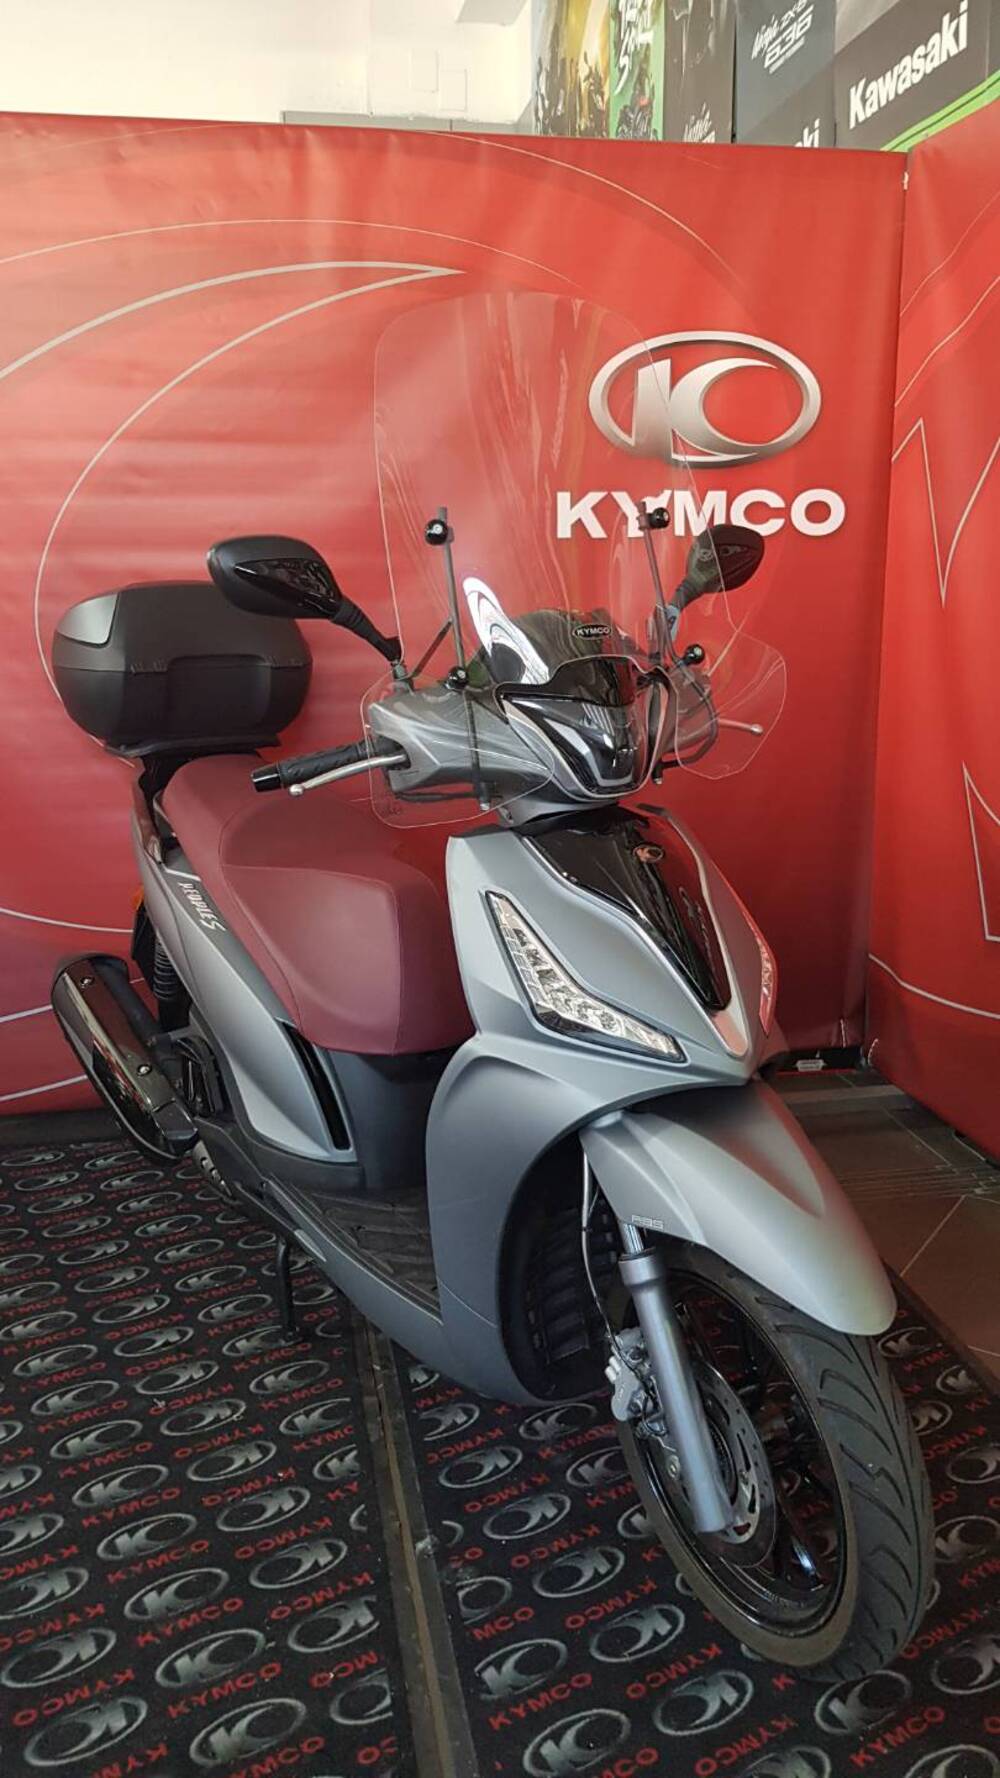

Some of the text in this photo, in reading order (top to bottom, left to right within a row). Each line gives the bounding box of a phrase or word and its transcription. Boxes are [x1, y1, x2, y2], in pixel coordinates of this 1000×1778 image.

[849, 0, 968, 130] Kawasaki
[556, 488, 846, 539] KYMCO
[576, 626, 610, 636] KYMCO
[67, 1256, 142, 1279] KYMCO
[161, 1251, 235, 1274] KYMCO
[2, 1297, 68, 1317] YMCO
[183, 1277, 256, 1306] KYMCO
[105, 1312, 185, 1341] KYMCO
[20, 1361, 106, 1393] KYMCO
[123, 1345, 208, 1377] KYMCO
[232, 1343, 311, 1373] KYMCO
[147, 1383, 235, 1417] KYMCO
[257, 1377, 344, 1412] KYMCO
[36, 1399, 128, 1434] KYMCO
[172, 1423, 265, 1461] KYMCO
[292, 1425, 353, 1452] KYMC
[60, 1441, 154, 1479] KYMCO
[201, 1467, 296, 1507] KYMCO
[464, 1473, 549, 1513] KYMCO
[81, 1487, 182, 1529] KYMCO
[234, 1516, 333, 1560] KYMCO
[511, 1524, 600, 1568] KYMCO
[0, 1545, 79, 1580] KYMC
[107, 1539, 209, 1584] KYMCO
[268, 1572, 372, 1620] KYMCO
[564, 1579, 656, 1631] KYMCO
[135, 1597, 244, 1648] KYMCO
[471, 1606, 534, 1640] MCO
[166, 1661, 282, 1718] KYMCO
[308, 1651, 379, 1689] MCO
[625, 1643, 720, 1700] KYMCO
[10, 1667, 135, 1727] KYMCO
[488, 1673, 592, 1730] KYMCO
[226, 1736, 325, 1778] YMCO
[694, 1718, 794, 1778] KYMCO
[848, 1706, 947, 1770] KYMCO
